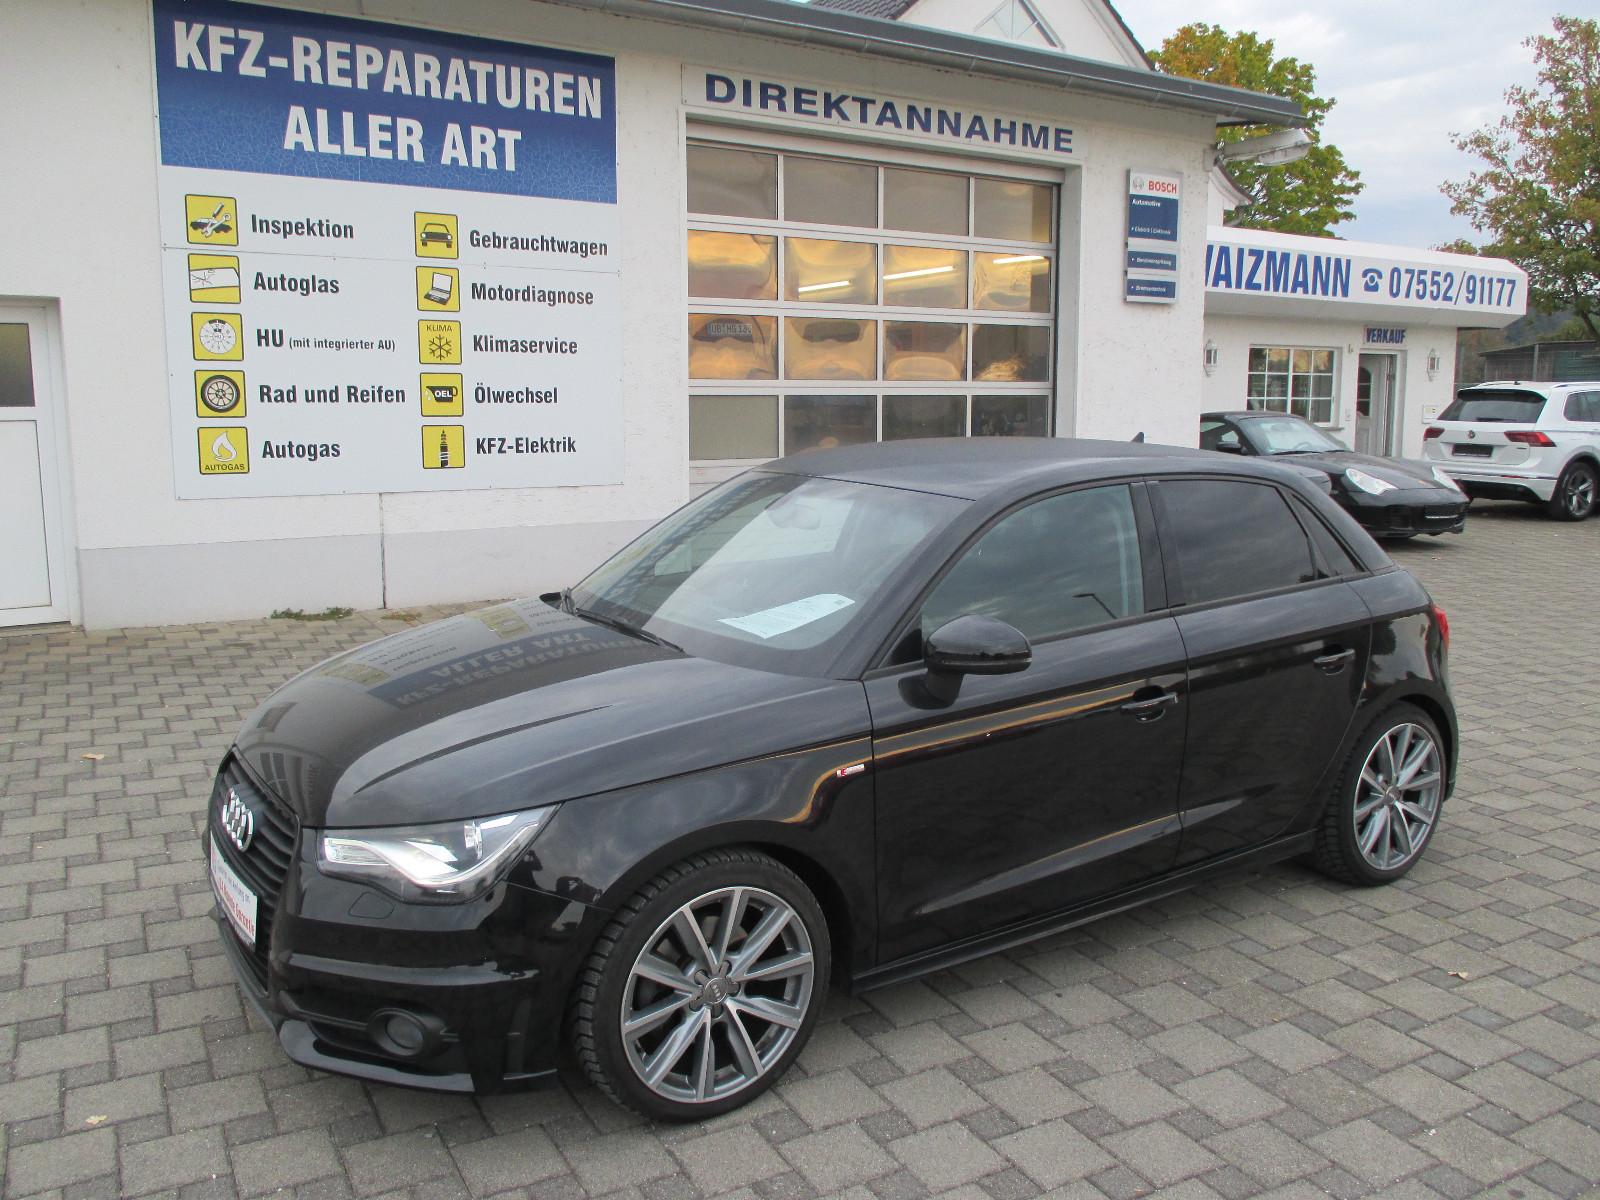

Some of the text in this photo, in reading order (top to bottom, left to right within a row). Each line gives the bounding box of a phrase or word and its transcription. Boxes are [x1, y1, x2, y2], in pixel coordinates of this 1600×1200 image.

[173, 20, 603, 120] KFZ-REPARATUREN
[704, 73, 1074, 154] DIREKTANNAHME
[283, 105, 522, 172] ALLER ART
[1148, 180, 1177, 194] BOSCH
[251, 214, 354, 239] Inspektion
[469, 229, 609, 258] Gebrauchtwagen
[253, 271, 341, 297] Autoglas
[1204, 244, 1517, 307] AIZMANN 07552/91177
[471, 282, 595, 307] Motordiagnose
[426, 324, 453, 333] KLIMA
[1365, 327, 1407, 345] VERKAUF
[256, 328, 396, 353] HU (mit integrierter AU)
[472, 334, 579, 355] Klimaservice
[259, 384, 407, 404] Rad und Reifen
[434, 389, 452, 399] OEL
[474, 382, 559, 405] Ölwechsel
[261, 440, 342, 462] Autogas
[476, 436, 578, 455] KFZ-Elektrik
[204, 463, 246, 472] AUTOGAS
